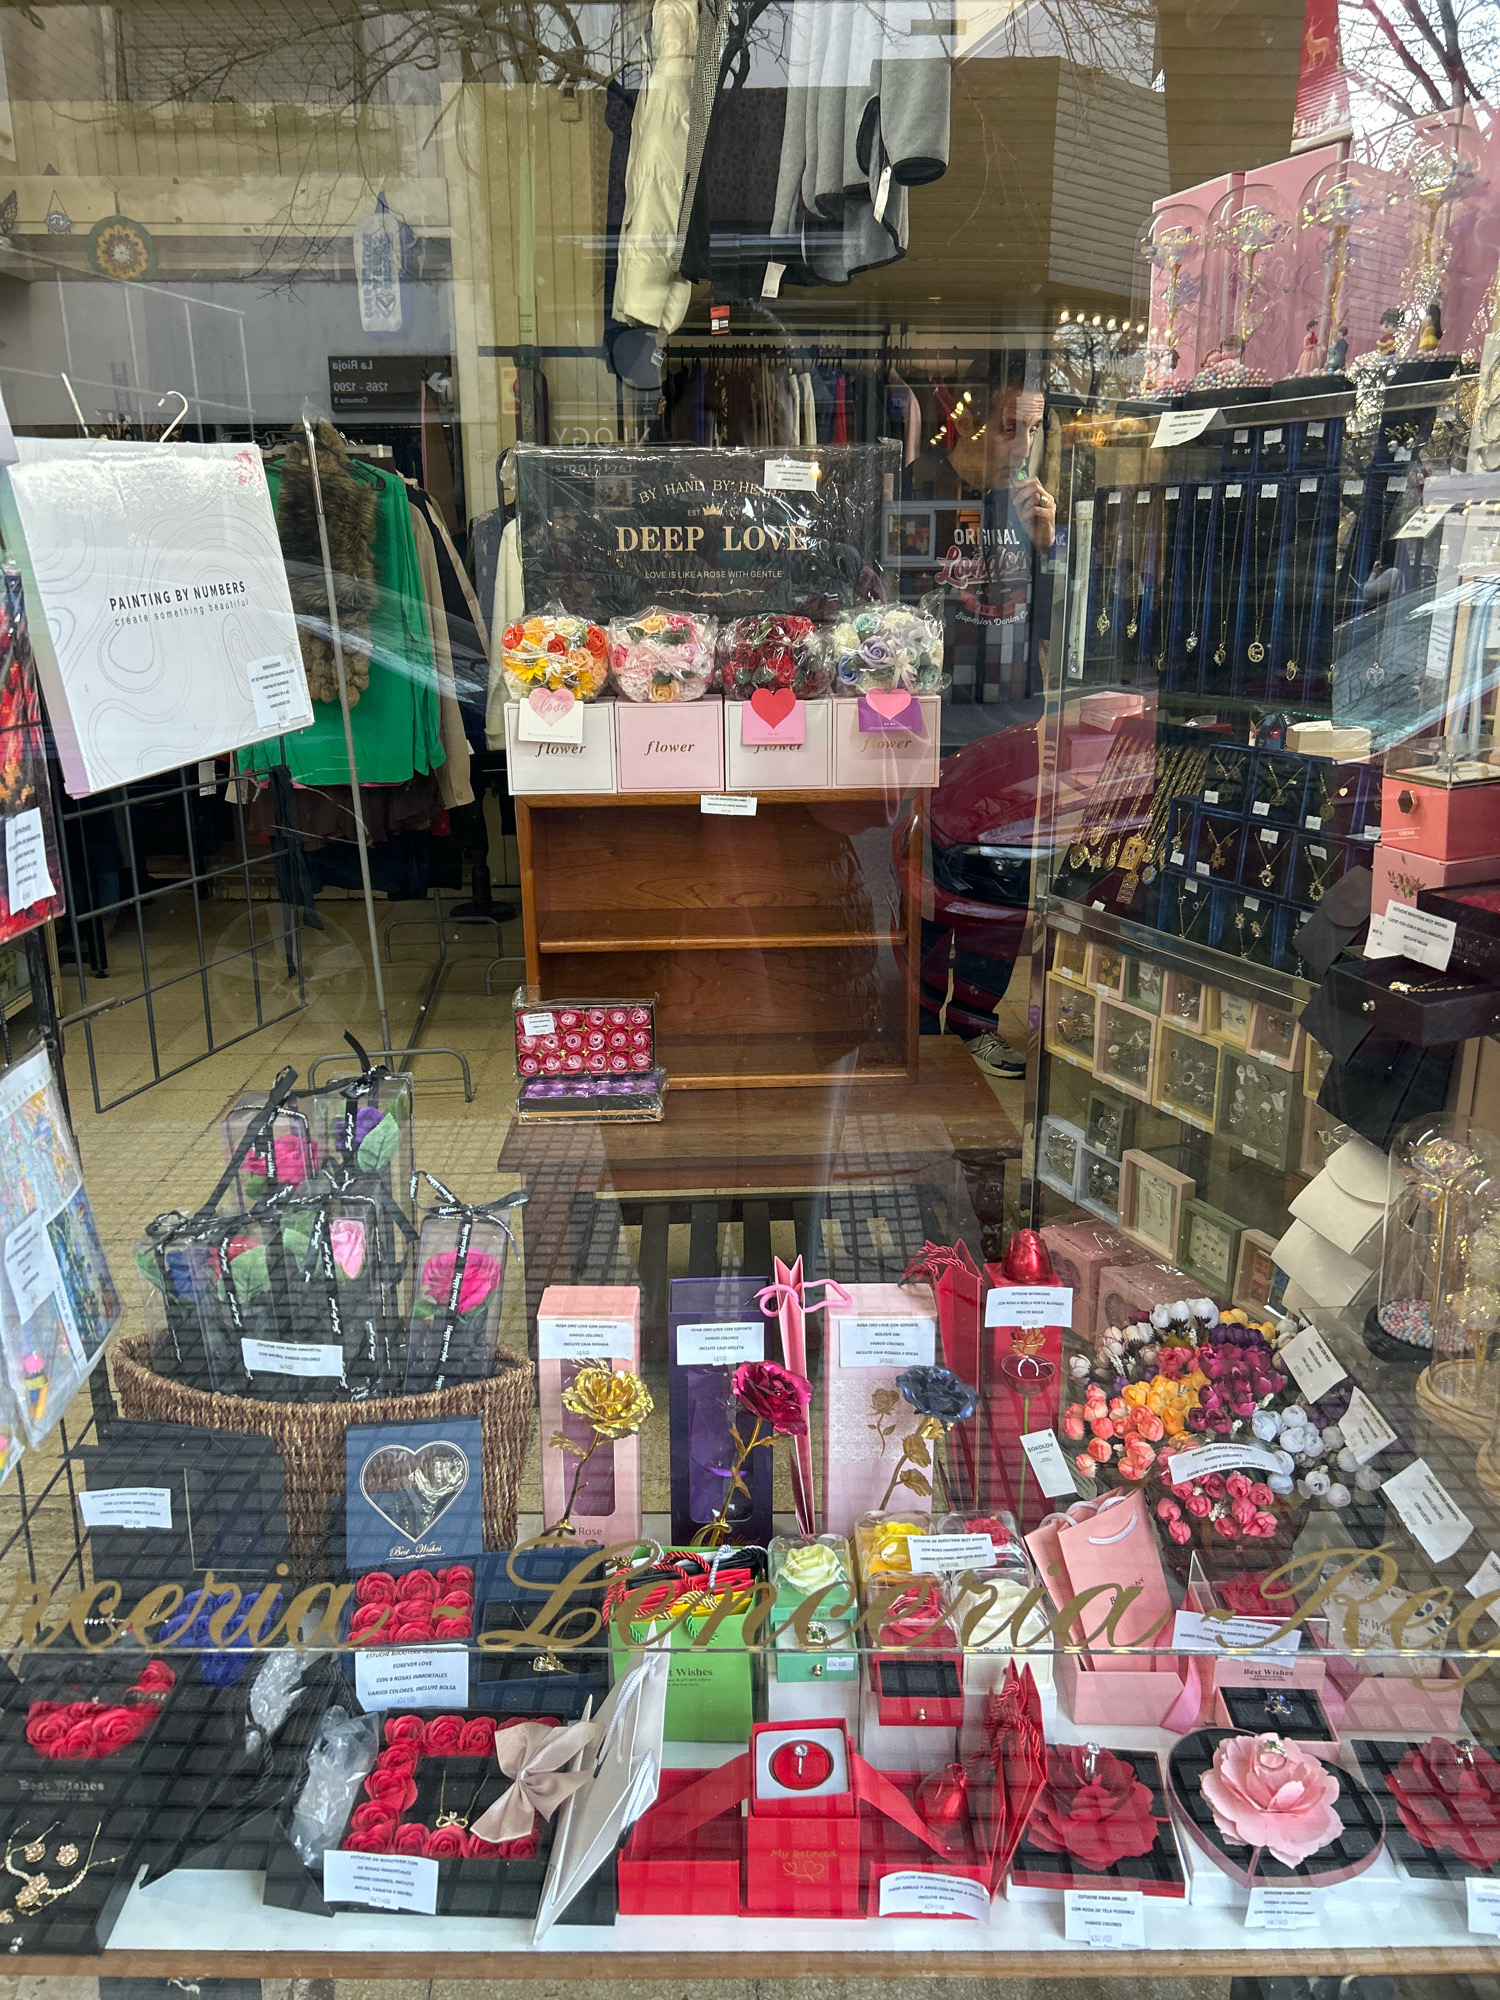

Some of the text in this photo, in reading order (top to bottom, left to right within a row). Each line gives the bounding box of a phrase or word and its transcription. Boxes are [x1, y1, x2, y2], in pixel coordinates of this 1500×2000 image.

[638, 488, 657, 504] BY
[713, 480, 730, 491] BY
[688, 509, 700, 517] EST
[616, 526, 808, 552] DEEP LOVE
[935, 545, 1032, 589] London
[645, 571, 666, 579] LOVE
[668, 571, 676, 579] IS
[678, 571, 695, 579] LIKE
[697, 571, 702, 579] A
[704, 571, 726, 579] ROSE
[109, 581, 246, 611] PAINTING BY NUMBERS
[115, 598, 249, 626] create something beautiful
[994, 615, 1019, 626] Denim
[539, 697, 567, 713] love
[535, 742, 586, 757] flower
[644, 740, 695, 755] flower
[861, 736, 912, 752] flower
[1027, 1442, 1053, 1452] SOKOLOV
[578, 1527, 603, 1536] Rose
[389, 1541, 442, 1556] Best Wishes
[477, 1535, 1175, 1670] Lenceria
[393, 1661, 417, 1669] FOREVER
[676, 1668, 712, 1676] Wishes
[19, 1780, 105, 1791] Best Wishes
[771, 1849, 837, 1859] My beloved
